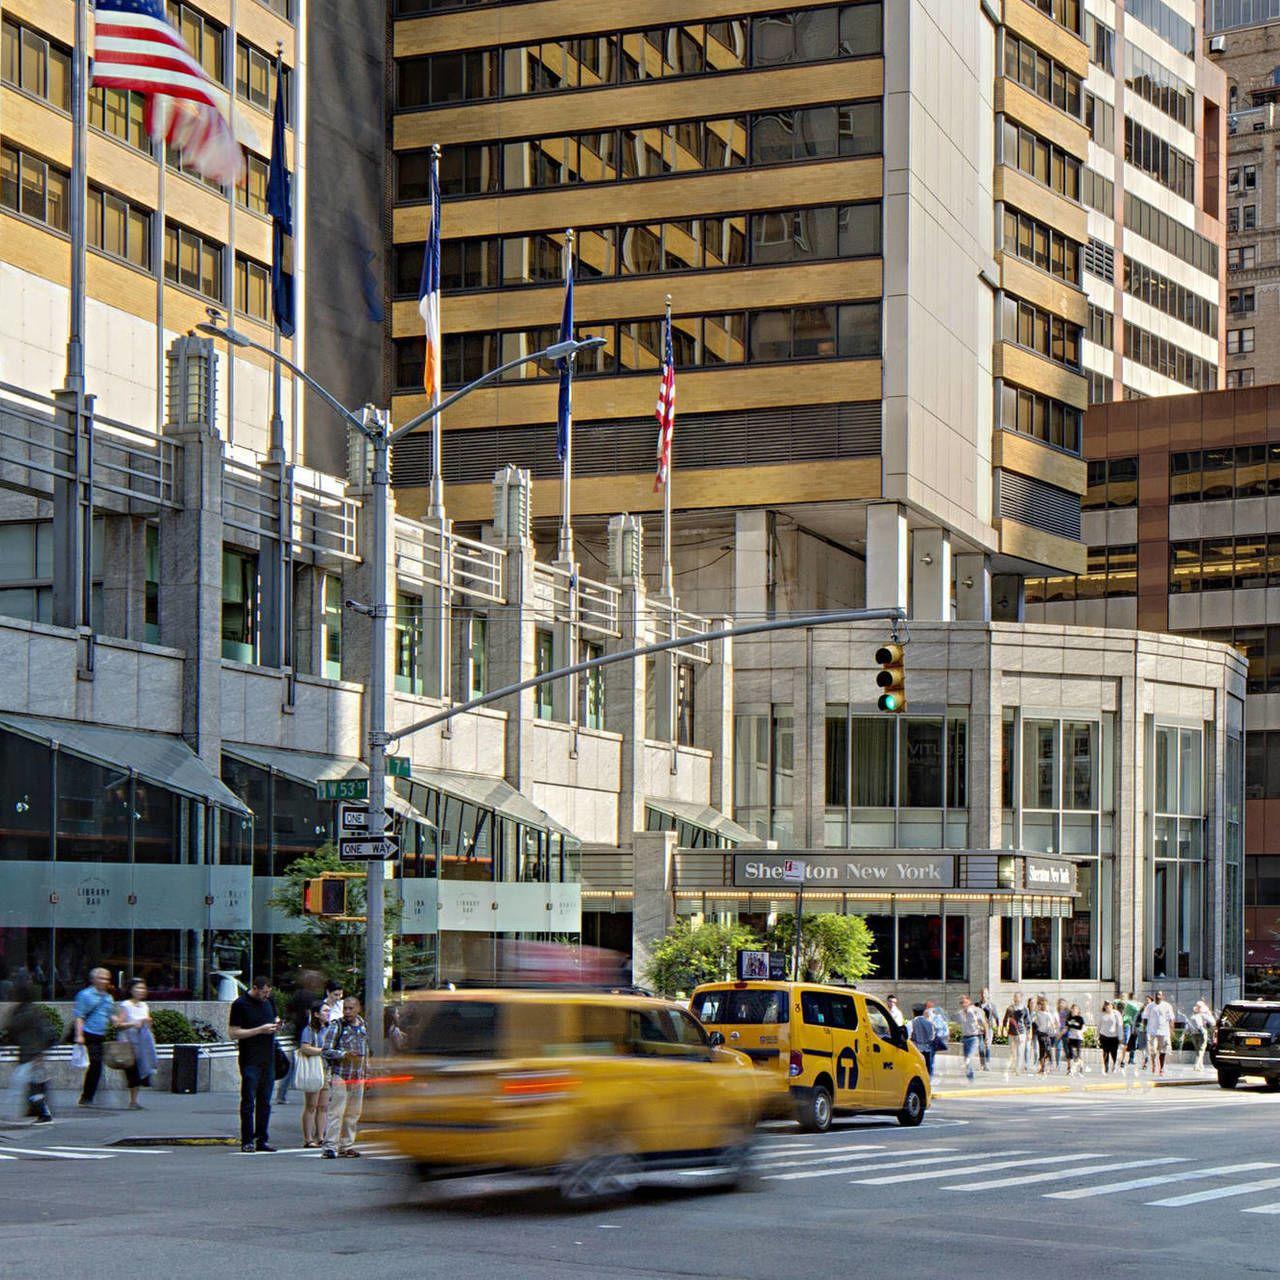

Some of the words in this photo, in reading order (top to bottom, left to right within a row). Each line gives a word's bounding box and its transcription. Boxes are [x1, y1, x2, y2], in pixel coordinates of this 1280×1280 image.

[329, 782, 338, 797] W
[340, 781, 354, 796] 53
[346, 813, 363, 824] ONE
[344, 845, 362, 855] ONE
[372, 844, 391, 854] WAY
[745, 862, 839, 881] Sheton
[847, 863, 887, 879] New
[896, 862, 942, 880] York
